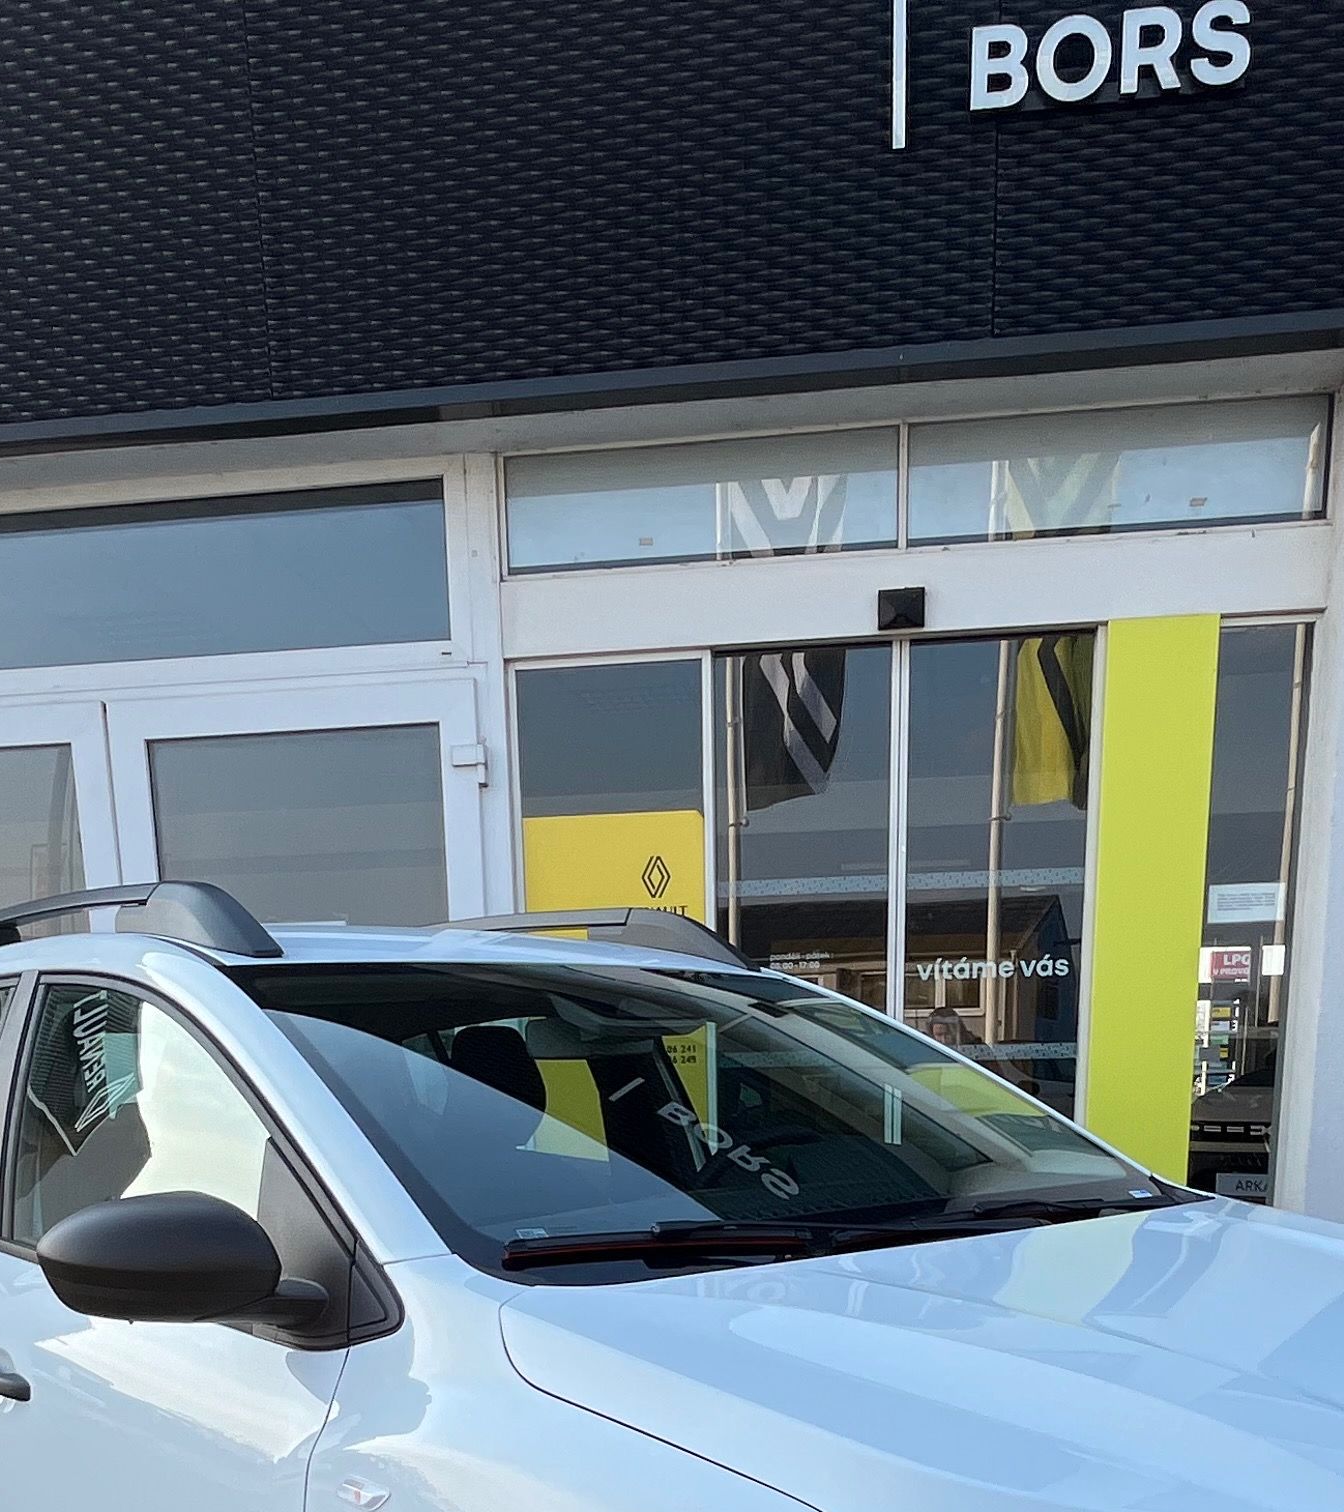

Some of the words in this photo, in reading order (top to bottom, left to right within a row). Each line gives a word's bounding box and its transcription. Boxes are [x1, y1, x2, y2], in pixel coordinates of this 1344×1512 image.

[969, 0, 1251, 111] BORS
[916, 956, 1015, 981] vítáme
[1019, 953, 1070, 978] vás
